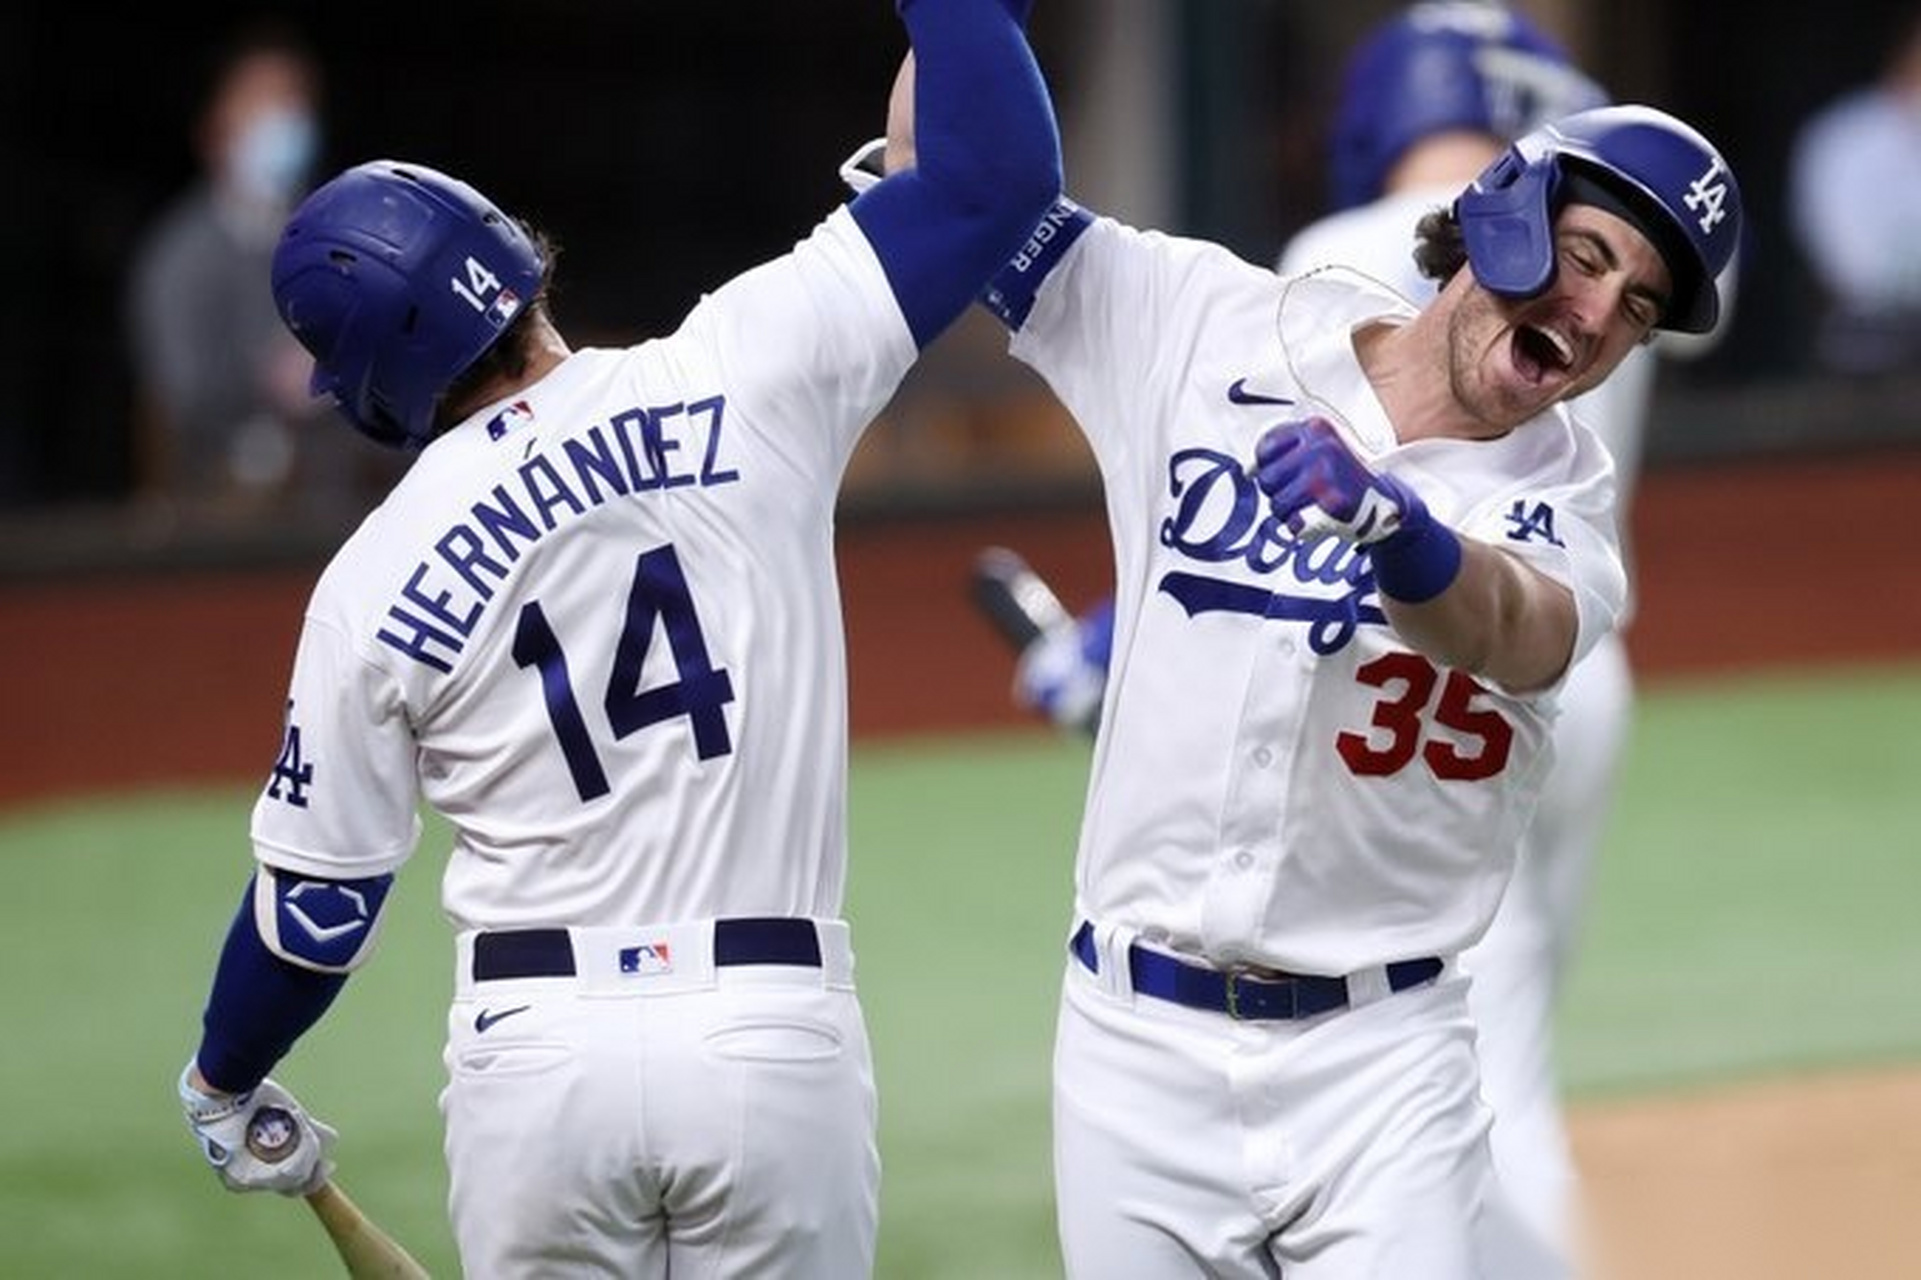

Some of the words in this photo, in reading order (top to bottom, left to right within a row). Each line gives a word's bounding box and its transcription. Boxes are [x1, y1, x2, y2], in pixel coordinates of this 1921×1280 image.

[1683, 156, 1727, 234] LA
[451, 256, 501, 312] 14
[376, 395, 739, 674] HERNÁNDEZ
[1504, 499, 1566, 549] LA
[511, 543, 735, 803] 14
[1336, 652, 1513, 781] 35
